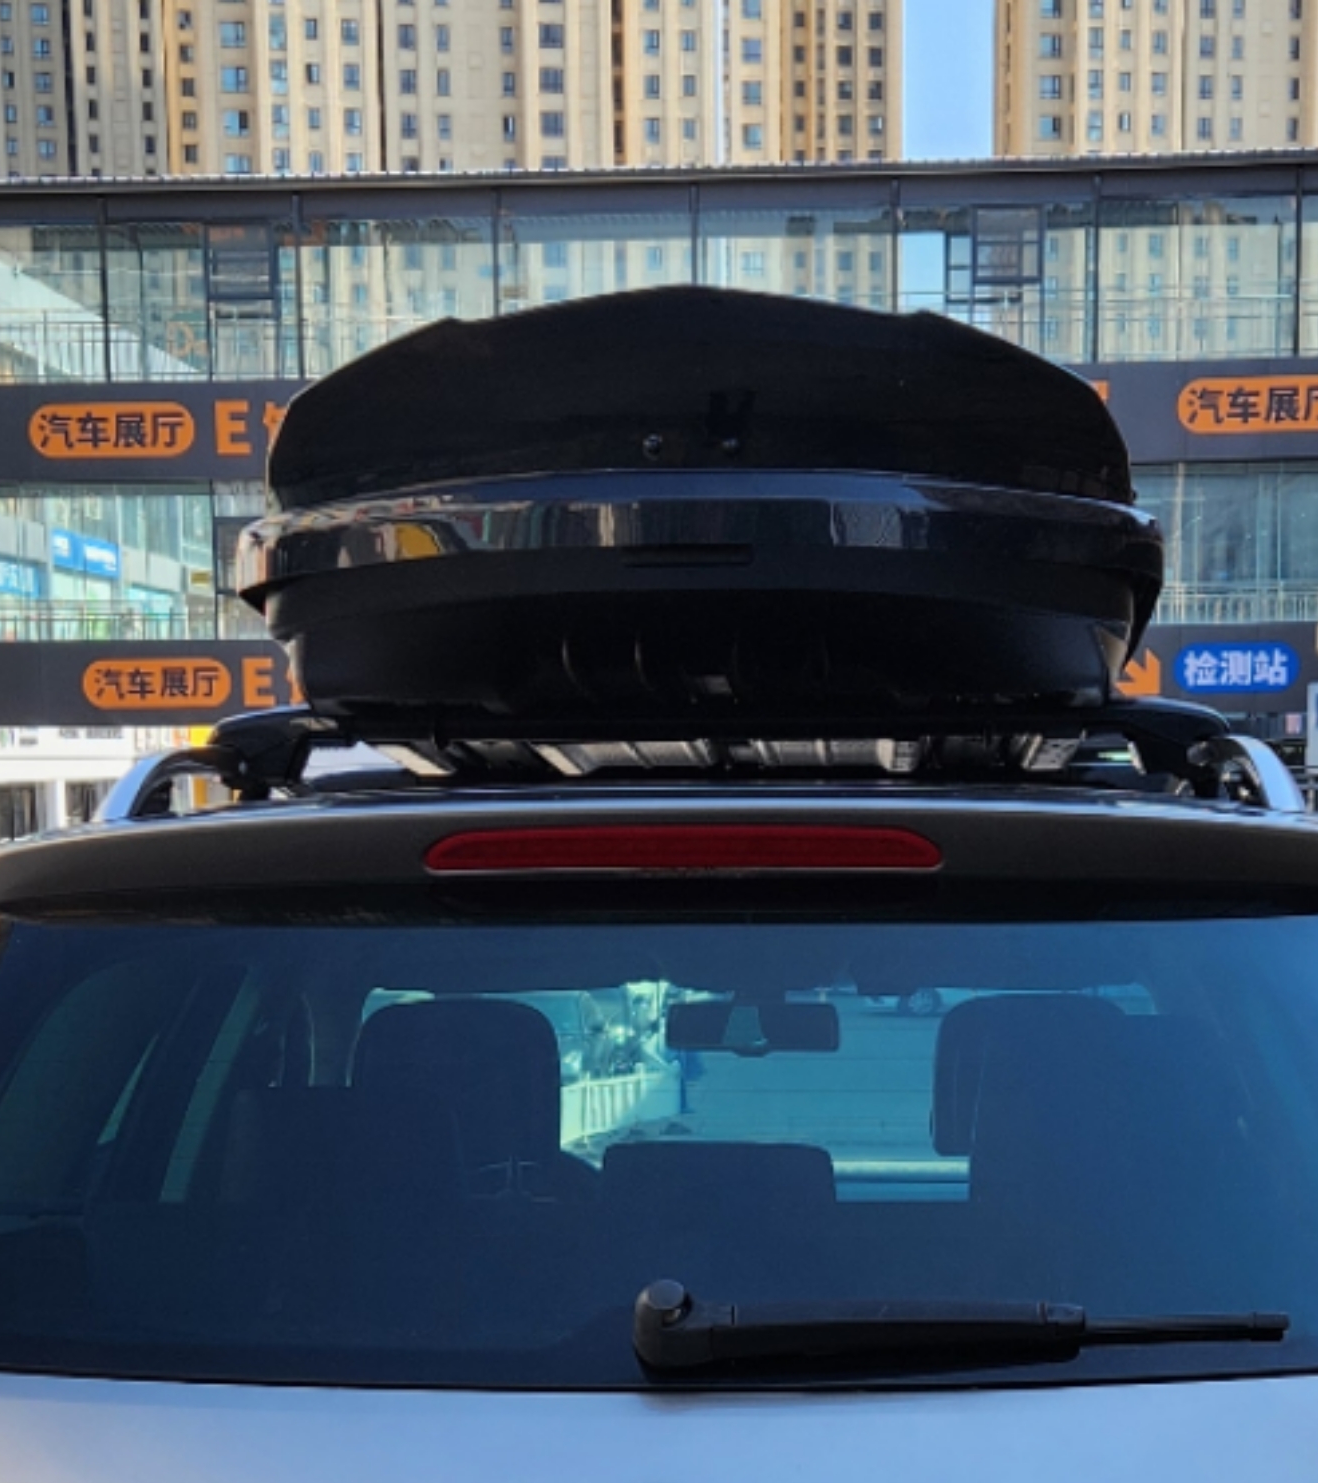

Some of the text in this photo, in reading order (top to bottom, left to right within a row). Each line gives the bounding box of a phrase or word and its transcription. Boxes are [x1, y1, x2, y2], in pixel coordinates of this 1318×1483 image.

[39, 411, 185, 450] 汽车展厅
[94, 667, 220, 700] 汽车展厅
[1183, 648, 1289, 687] 检测站
